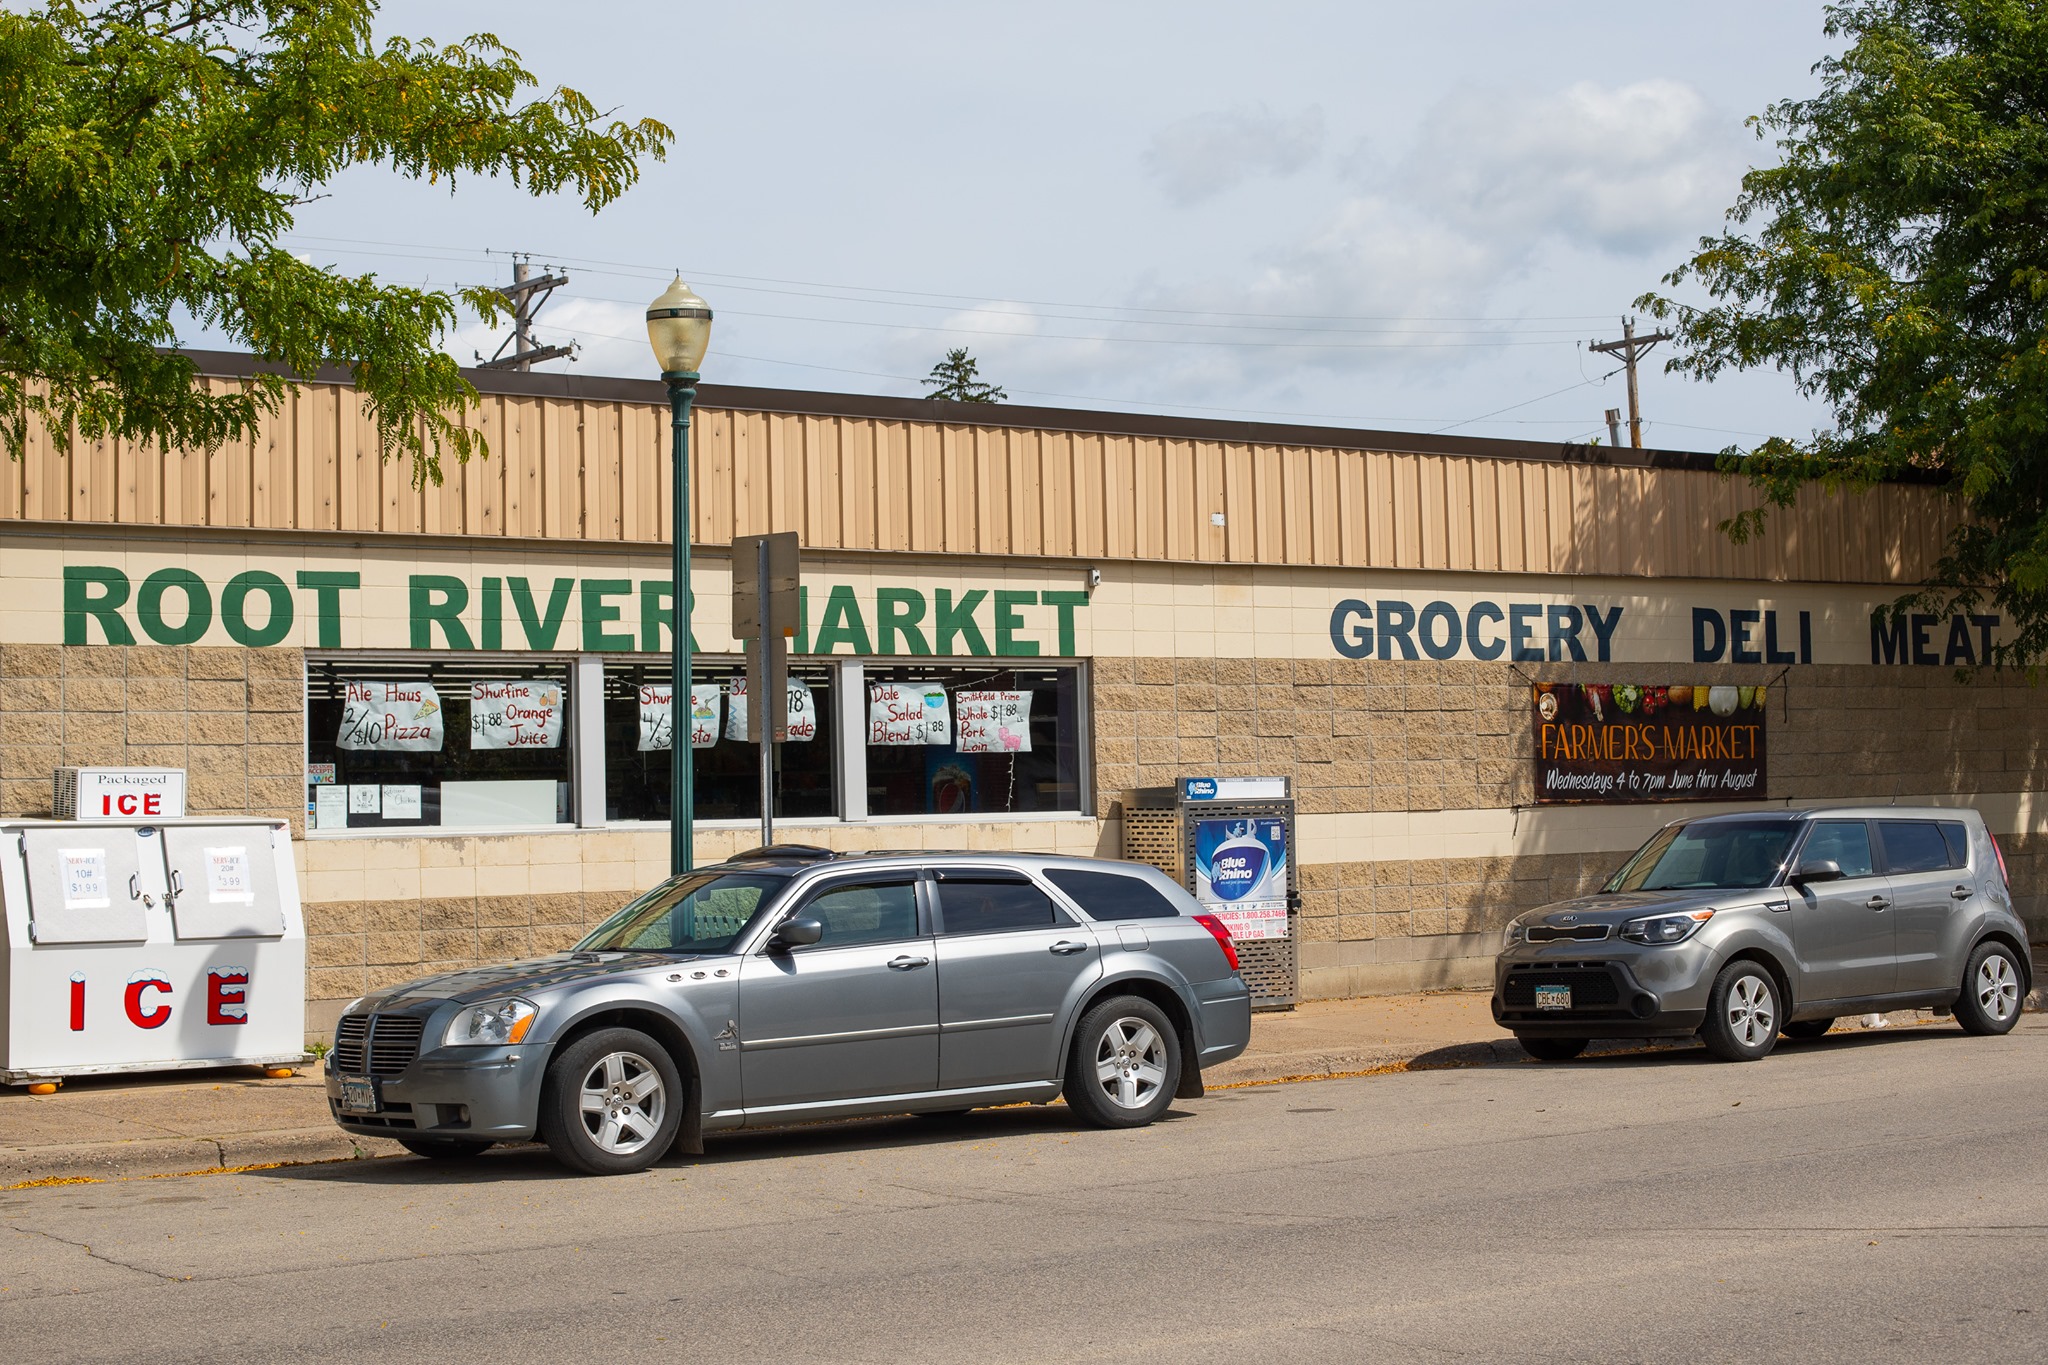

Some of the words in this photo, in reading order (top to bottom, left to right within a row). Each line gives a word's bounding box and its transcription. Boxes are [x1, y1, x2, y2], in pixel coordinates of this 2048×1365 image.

[63, 566, 360, 647] ROOT
[409, 575, 698, 652] RIVER
[1329, 599, 1624, 662] GROCERY
[1692, 606, 1813, 665] DELI
[1870, 613, 2000, 665] MEAT
[346, 682, 373, 702] Ale
[385, 683, 422, 703] Haus
[474, 683, 530, 700] Shurfine
[641, 686, 697, 705] Shure
[872, 685, 900, 703] Dole
[1000, 691, 1020, 701] Prime
[506, 704, 553, 728] Orange
[888, 703, 923, 722] Salad
[958, 706, 988, 721] Whole
[384, 713, 431, 740] Pizza
[508, 723, 549, 746] Juice
[873, 720, 911, 743] Blend
[961, 720, 986, 739] Pork
[962, 737, 988, 752] Loin
[1541, 723, 1655, 761] FARMER'S
[1663, 724, 1760, 760] MARKET
[98, 774, 167, 787] Packaged
[313, 775, 334, 783] WIC
[1546, 768, 1612, 794] Wednesdays
[1616, 771, 1626, 790] 4
[1629, 770, 1639, 790] to
[1643, 772, 1666, 792] 7pm
[1668, 769, 1693, 790] June
[1696, 769, 1719, 789] thru
[1721, 768, 1758, 790] August
[103, 791, 161, 816] ICE
[220, 864, 234, 872] 20#
[1221, 857, 1247, 870] Blue
[75, 869, 92, 879] 10#
[1219, 868, 1254, 881] Rhino
[70, 966, 249, 1031] ICE
